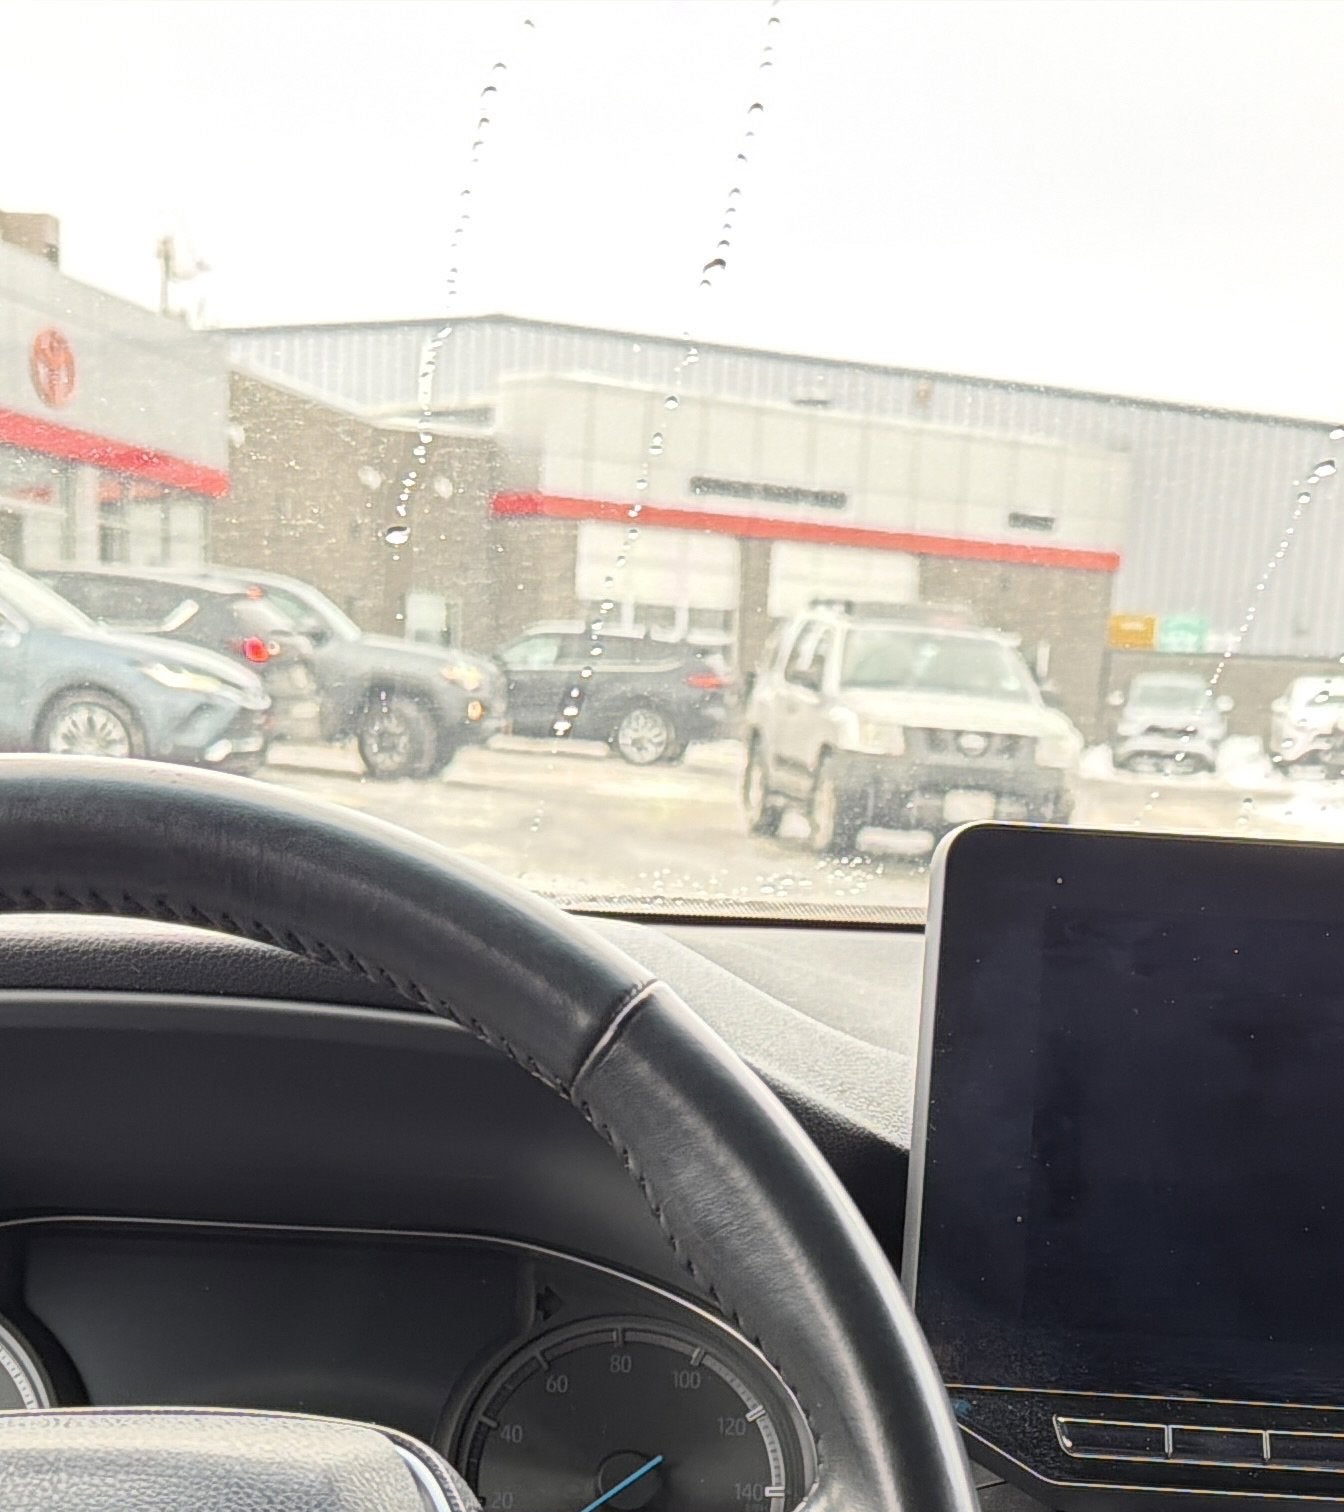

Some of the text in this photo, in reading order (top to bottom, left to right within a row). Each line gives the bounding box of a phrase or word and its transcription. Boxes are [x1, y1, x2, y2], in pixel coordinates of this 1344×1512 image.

[610, 1355, 631, 1373] 80
[546, 1375, 568, 1394] 60
[672, 1371, 700, 1390] 100
[500, 1425, 523, 1444] 40
[717, 1418, 746, 1437] 120
[492, 1491, 513, 1509] 20
[735, 1482, 763, 1501] 140
